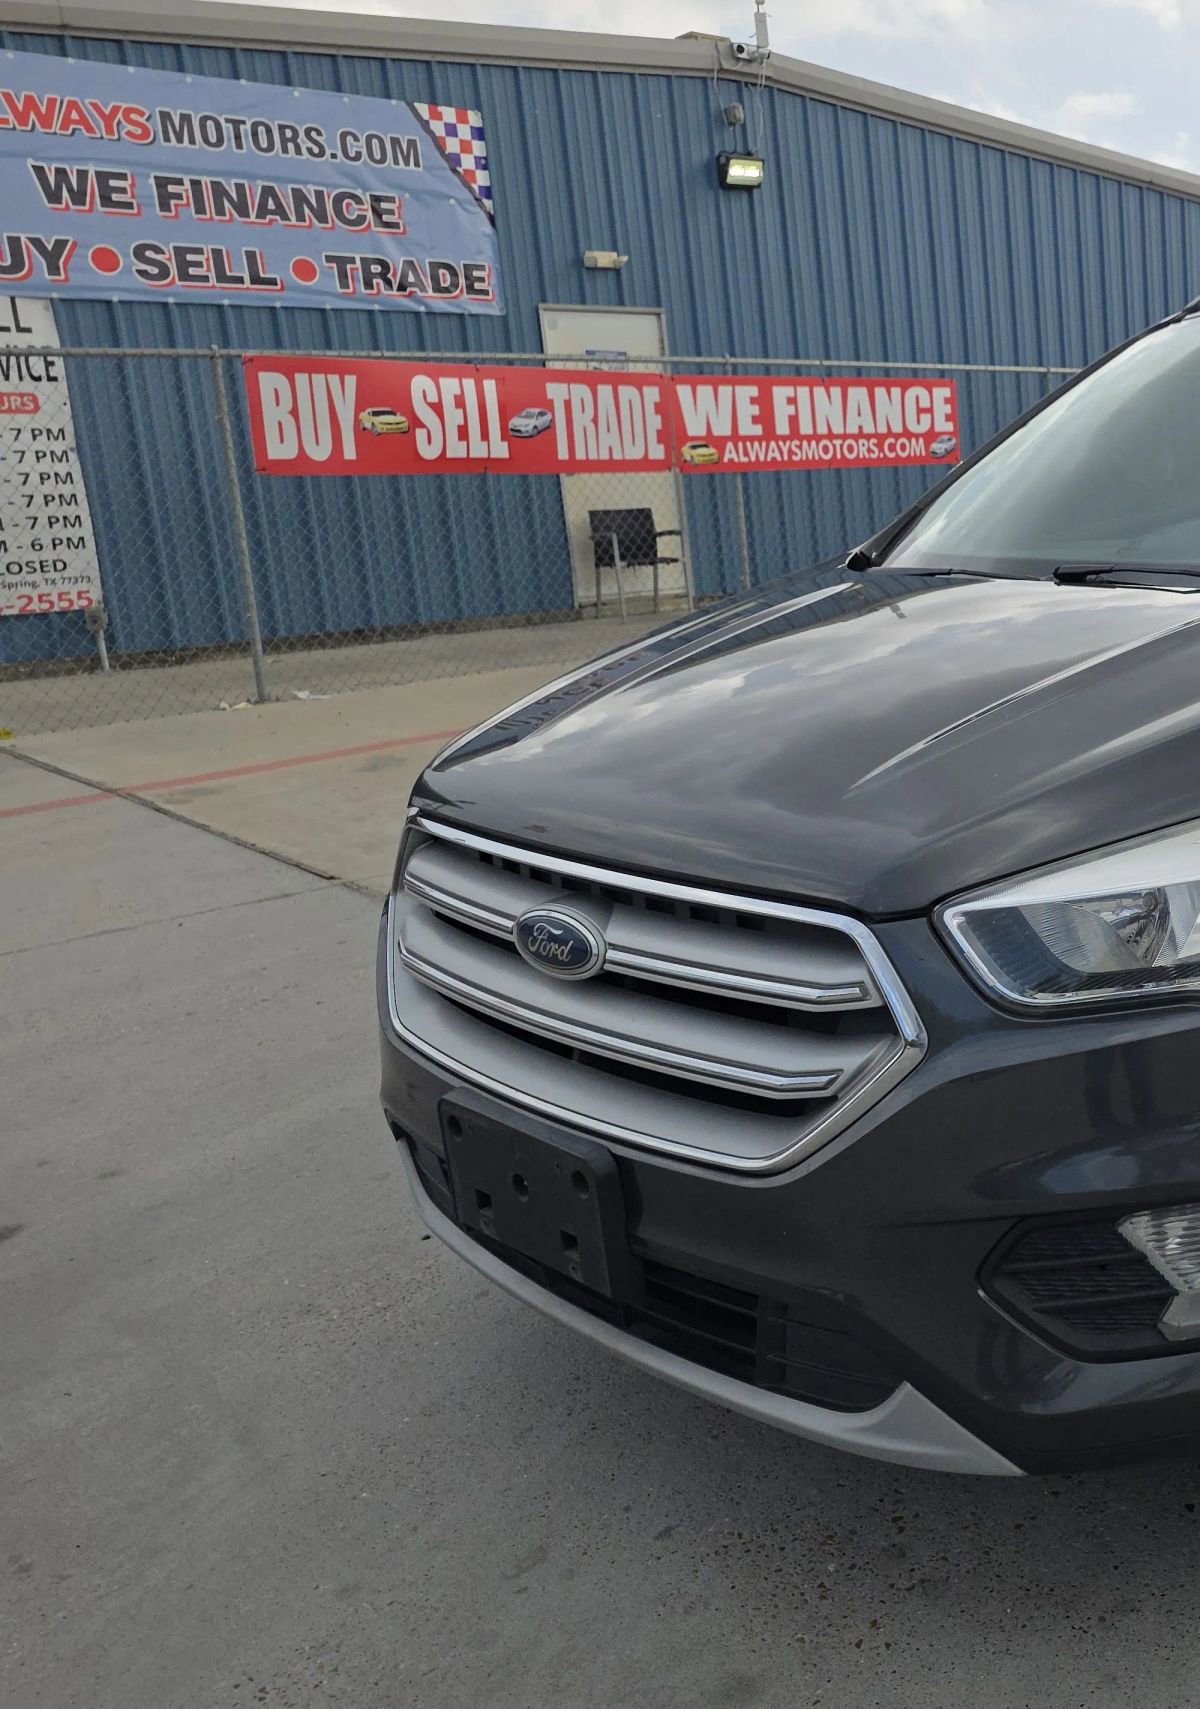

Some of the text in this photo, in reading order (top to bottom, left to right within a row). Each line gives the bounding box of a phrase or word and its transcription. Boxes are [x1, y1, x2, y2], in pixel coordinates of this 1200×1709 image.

[31, 163, 403, 232] WE FINANCE
[132, 243, 281, 287] SELL
[324, 254, 492, 297] TRADE
[258, 371, 665, 462] BUY SELL TRADE
[676, 384, 954, 437] WE FINANCE
[9, 427, 66, 442] 7 PM
[13, 450, 26, 464] 7
[35, 450, 70, 464] PM
[723, 437, 926, 463] ALWAYSMOTORS.COM
[17, 472, 30, 486] 7
[39, 471, 74, 486] PM
[21, 494, 34, 508] 7
[43, 493, 78, 508] PM
[25, 516, 39, 530] 7
[48, 515, 82, 529] PM
[31, 538, 43, 552] 6
[52, 536, 86, 551] PM
[0, 590, 94, 614] -2555
[528, 922, 573, 961] Ford
